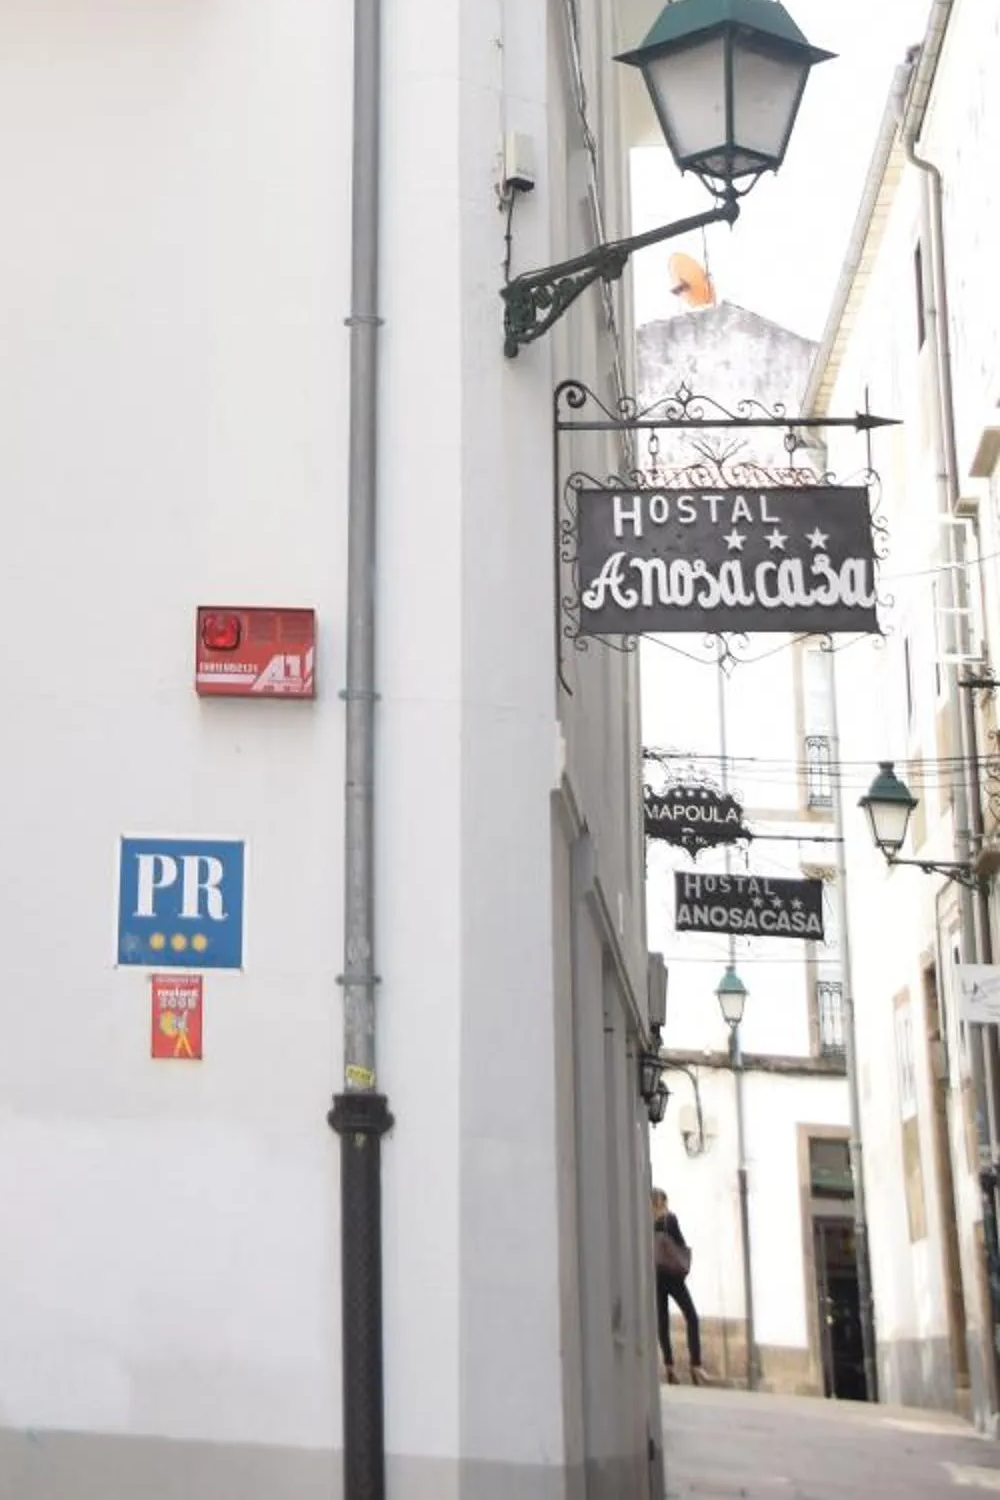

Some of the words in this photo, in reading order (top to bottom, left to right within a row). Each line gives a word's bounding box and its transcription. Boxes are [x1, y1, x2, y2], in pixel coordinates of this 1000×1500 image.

[612, 495, 782, 538] HOSTAL
[132, 853, 229, 921] PR
[684, 874, 777, 899] HOSTAL
[677, 903, 821, 934] ANOSACASA
